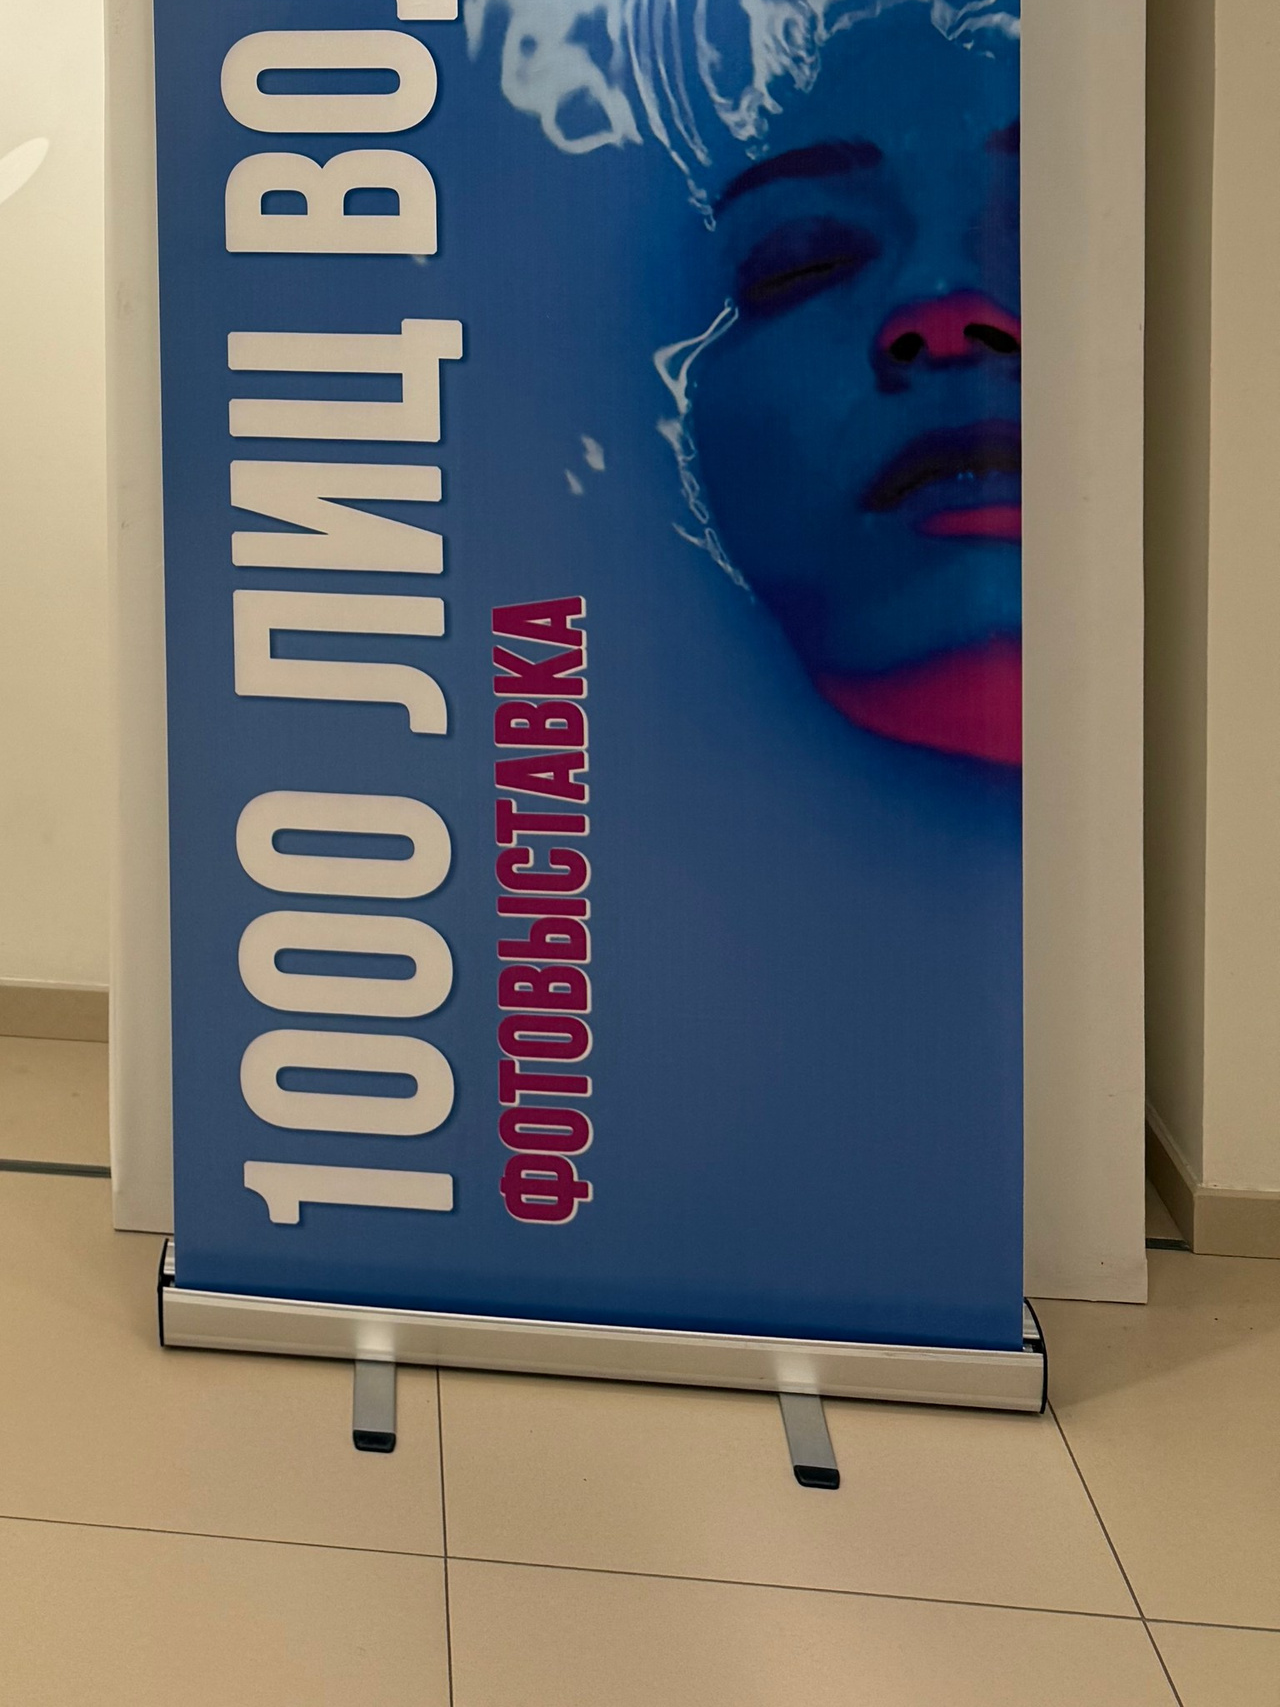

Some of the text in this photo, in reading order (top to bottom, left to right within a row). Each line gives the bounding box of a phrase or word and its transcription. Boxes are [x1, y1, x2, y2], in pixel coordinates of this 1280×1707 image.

[227, 318, 463, 735] ЛИЦ
[235, 789, 455, 1224] 1000
[492, 595, 593, 1224] ФОТОВЫСТАВКА
